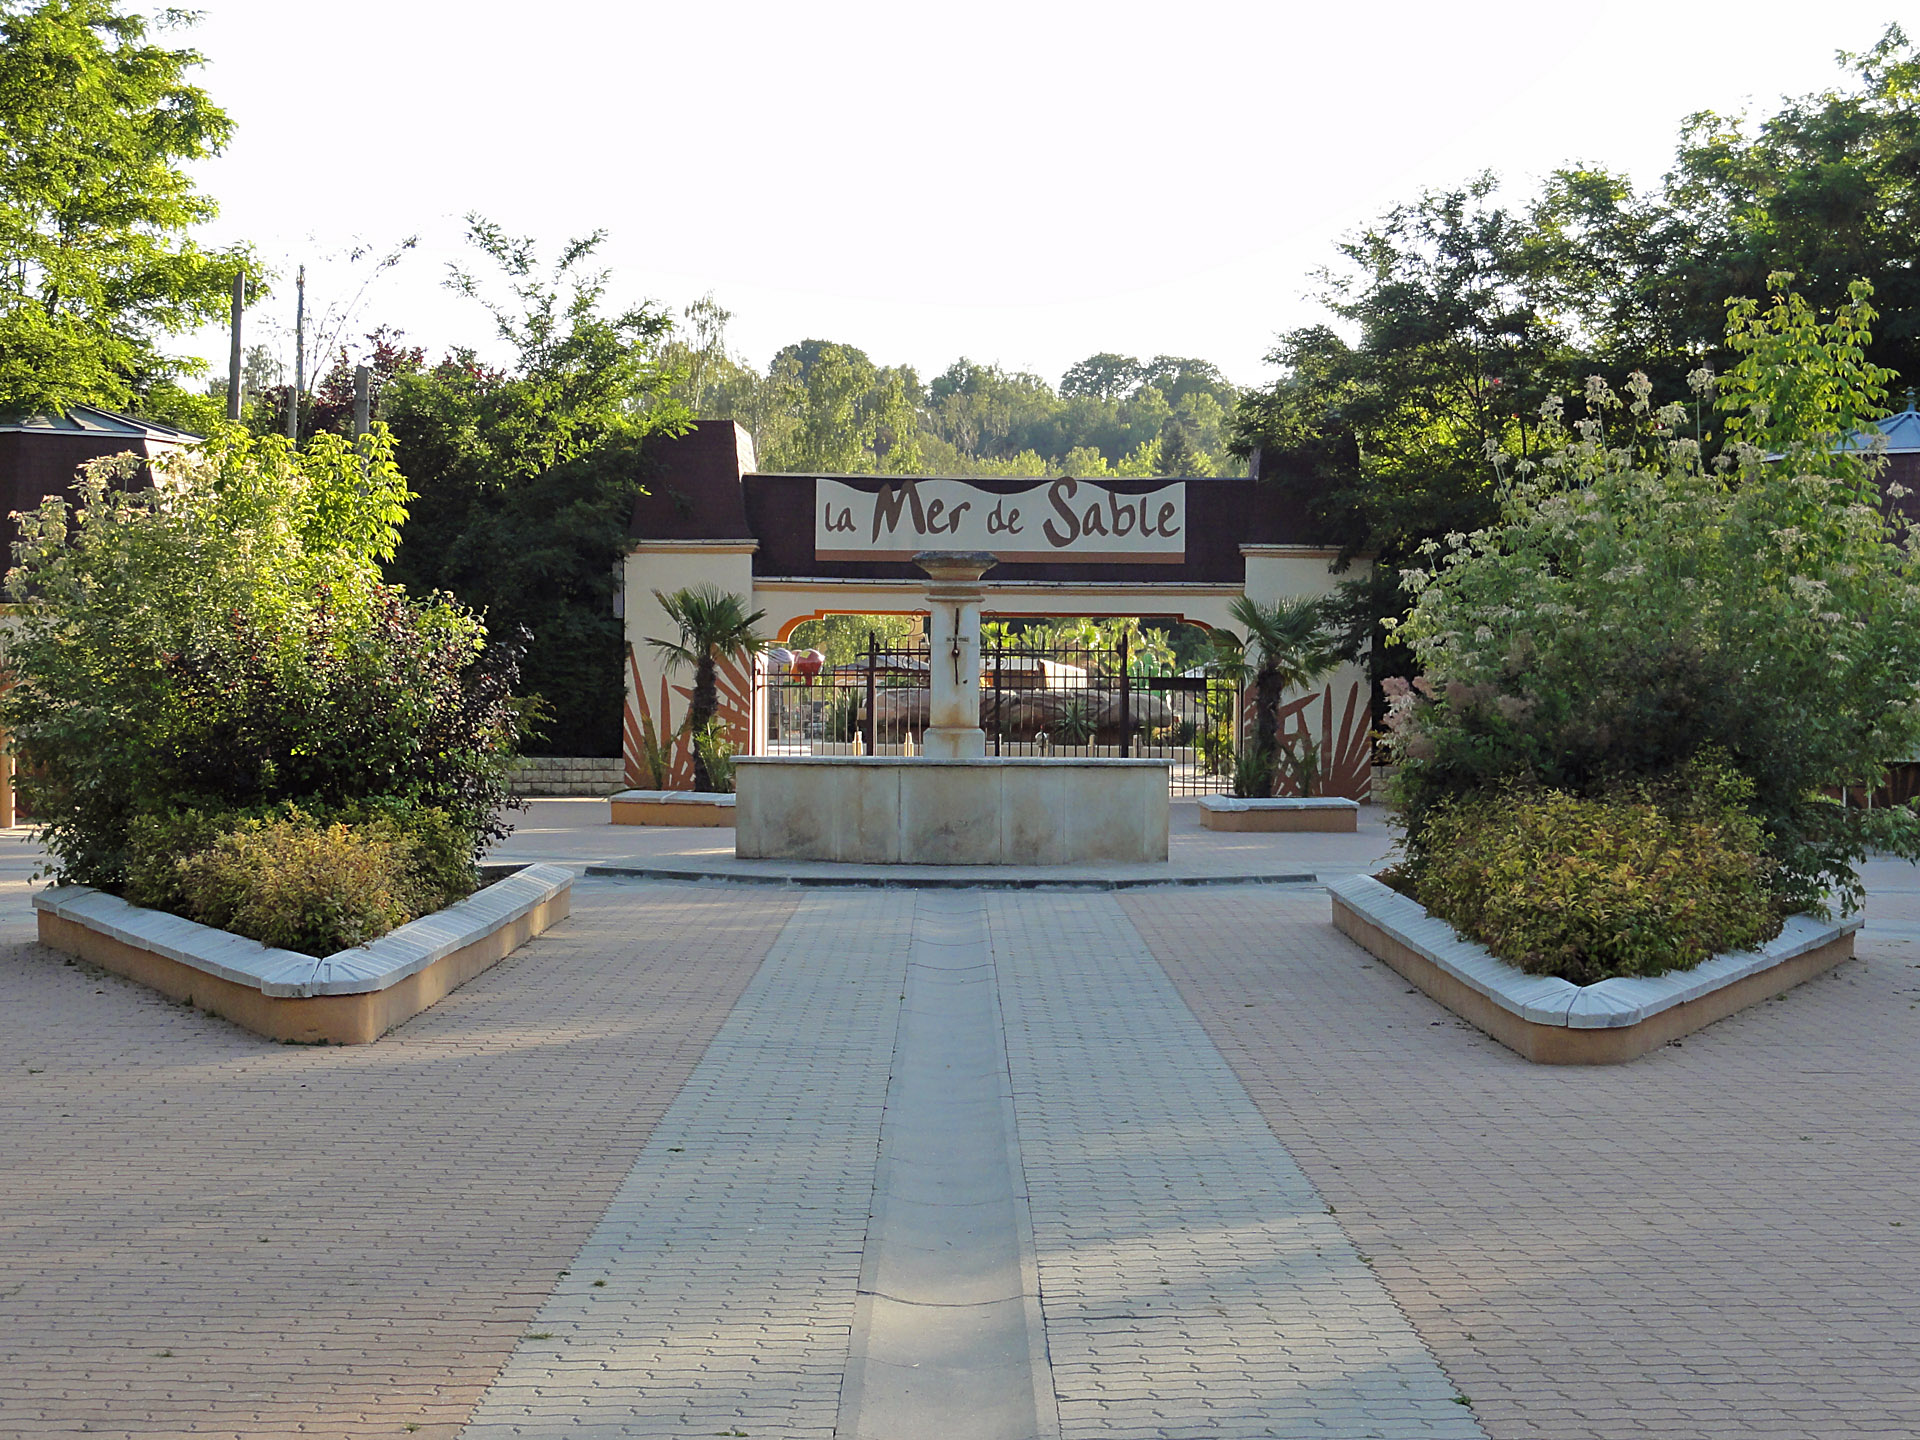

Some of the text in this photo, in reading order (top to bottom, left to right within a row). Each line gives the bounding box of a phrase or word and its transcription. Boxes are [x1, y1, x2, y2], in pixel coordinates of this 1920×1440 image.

[825, 476, 1181, 548] la Mer de Sable
